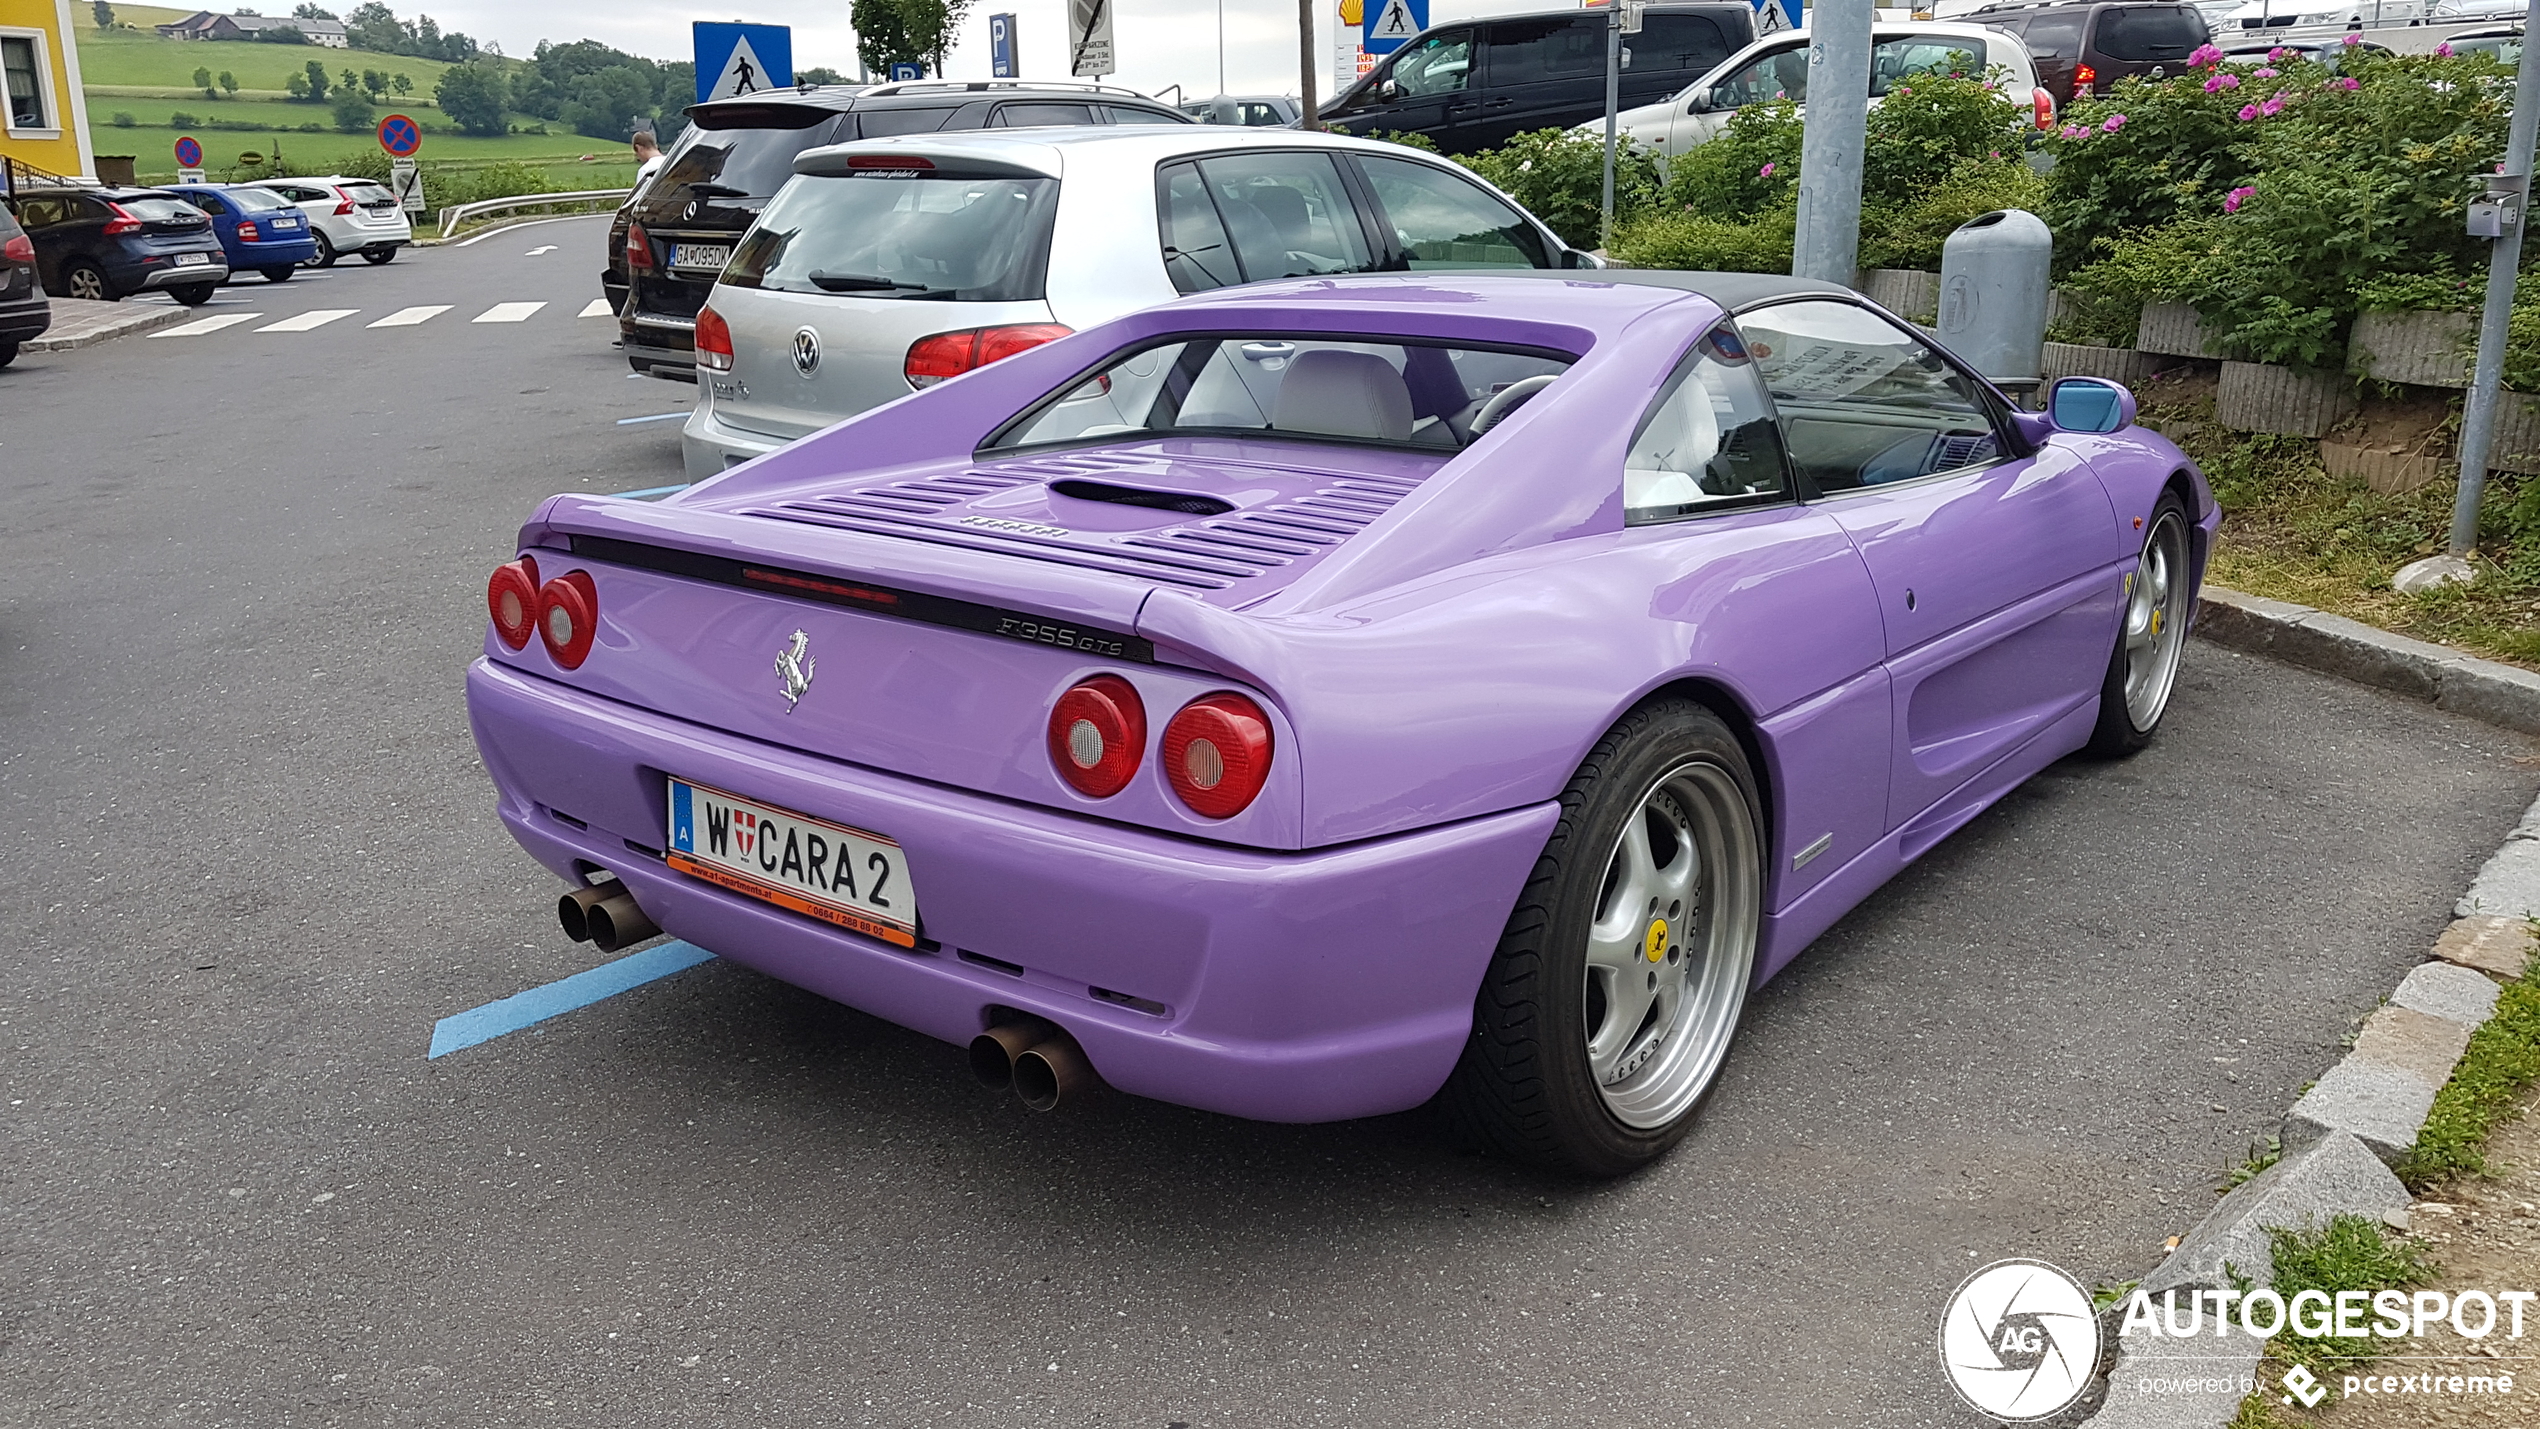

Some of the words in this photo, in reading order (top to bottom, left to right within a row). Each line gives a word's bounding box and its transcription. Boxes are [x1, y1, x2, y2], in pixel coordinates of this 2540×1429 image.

[992, 19, 1005, 58] P
[676, 245, 689, 265] GA
[695, 246, 728, 267] 095DK
[995, 617, 1077, 647] F355
[1078, 637, 1123, 656] GTS
[679, 826, 689, 842] A
[706, 801, 729, 857] W
[759, 819, 857, 899] CARA
[868, 852, 890, 908] 2
[690, 866, 772, 899] www.a1-apartments.at
[813, 906, 834, 920] 0664
[842, 915, 858, 928] 288
[860, 921, 871, 932] 88
[873, 926, 884, 937] 02
